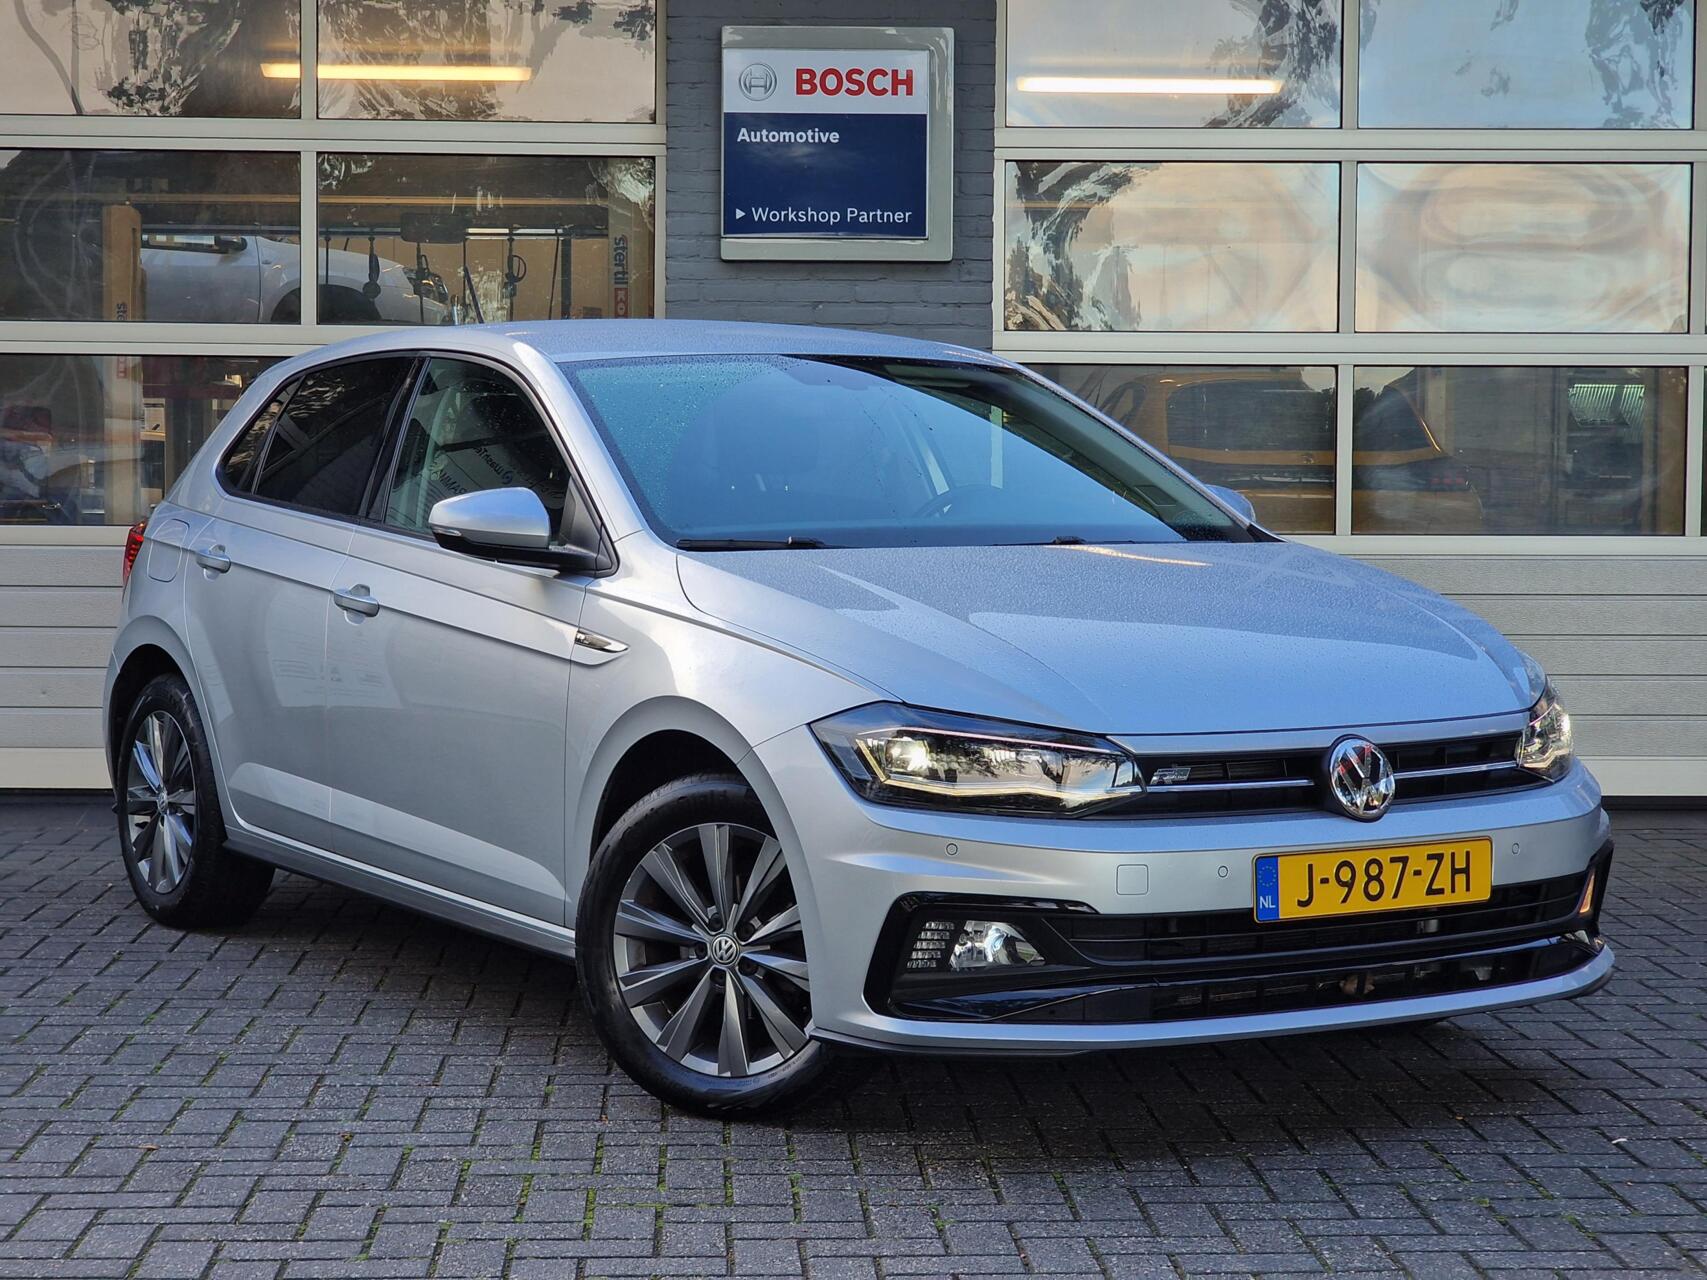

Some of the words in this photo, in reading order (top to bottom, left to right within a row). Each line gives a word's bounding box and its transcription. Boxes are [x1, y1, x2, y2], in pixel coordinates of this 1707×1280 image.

[795, 67, 914, 97] BOSCH
[736, 127, 841, 144] Automotive
[751, 206, 842, 226] Workshop
[846, 207, 912, 224] Partner
[613, 234, 629, 286] stertil
[1297, 850, 1471, 908] J-987-ZH
[1259, 895, 1276, 909] NL
